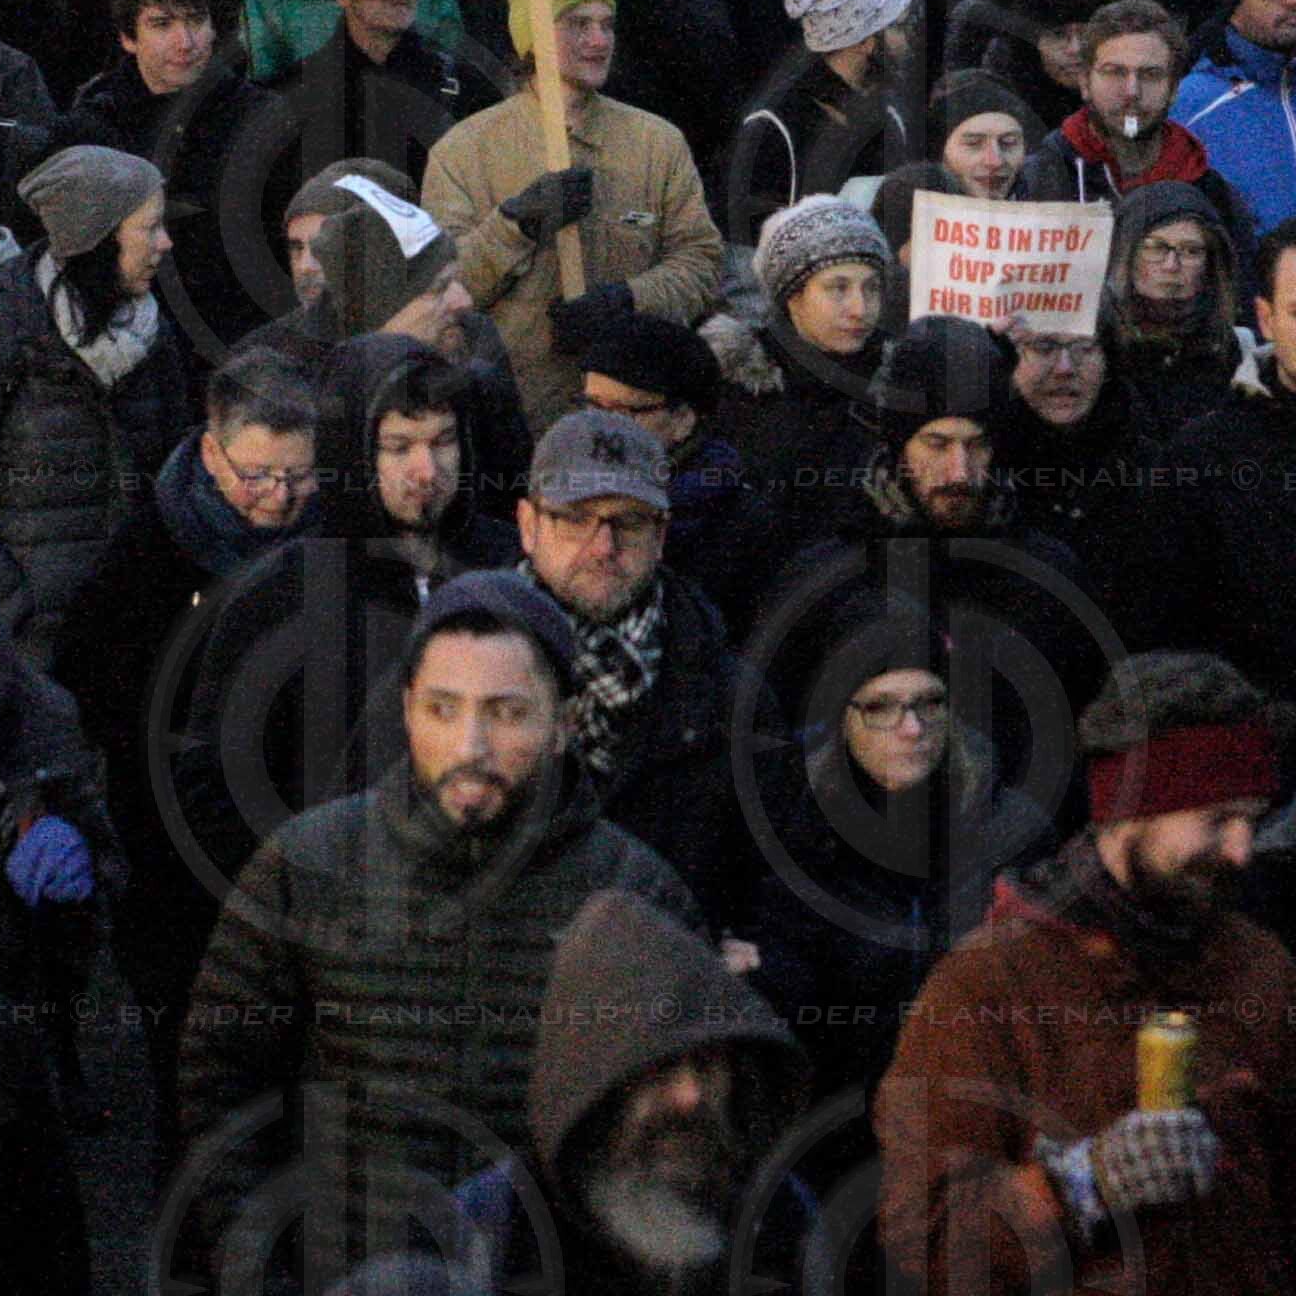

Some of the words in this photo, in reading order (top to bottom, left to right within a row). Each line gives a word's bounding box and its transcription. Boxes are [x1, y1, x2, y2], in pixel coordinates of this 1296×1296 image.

[934, 218, 981, 247] DAS
[986, 226, 1001, 251] B
[1007, 227, 1033, 253] IN
[948, 253, 994, 284] ÖVP
[1001, 262, 1071, 284] STEHT
[929, 286, 972, 314] FÜR
